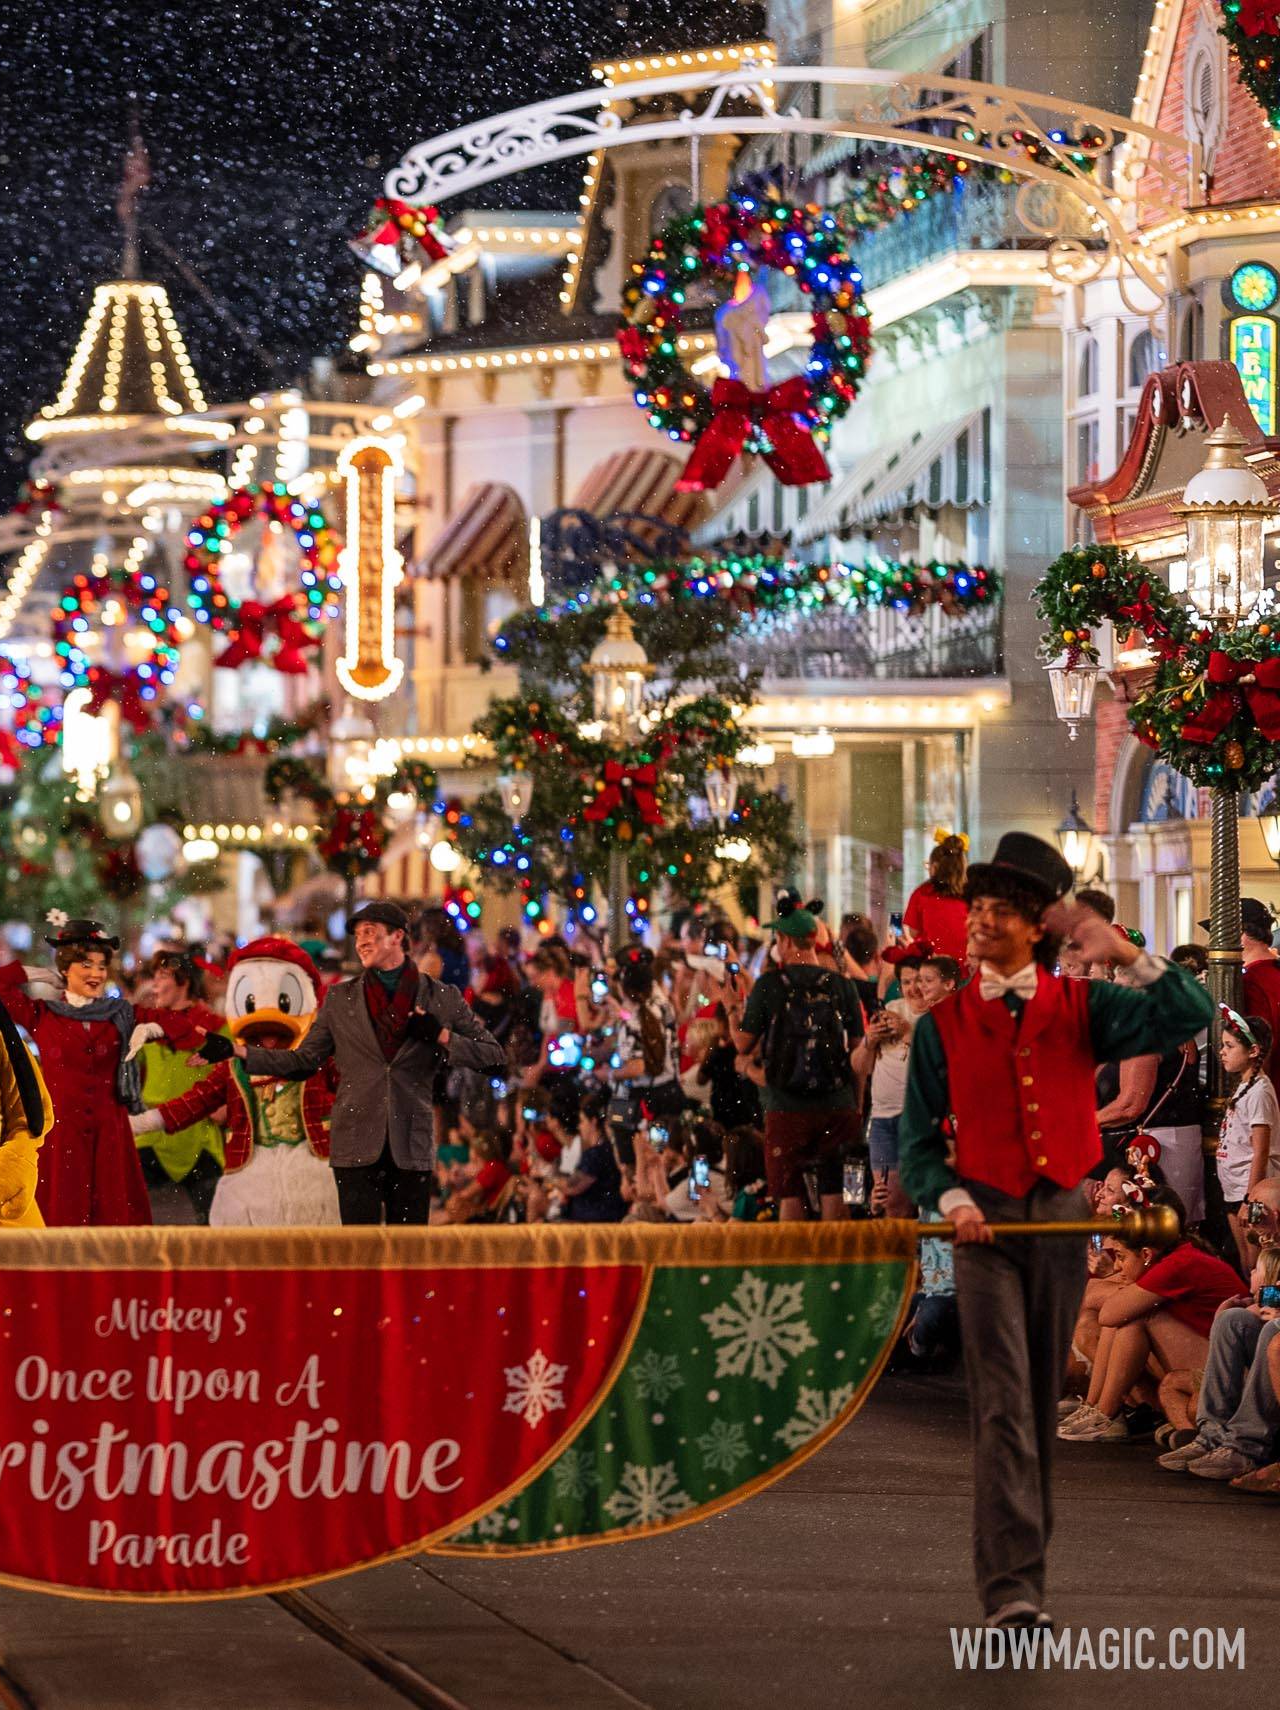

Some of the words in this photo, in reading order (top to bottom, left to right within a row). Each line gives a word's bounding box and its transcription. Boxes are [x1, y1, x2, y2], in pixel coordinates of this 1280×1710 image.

[94, 1297, 247, 1343] Mickey's
[15, 1354, 133, 1403] Once
[146, 1355, 261, 1415] Upon
[275, 1354, 325, 1410] A
[87, 1518, 251, 1568] Parade
